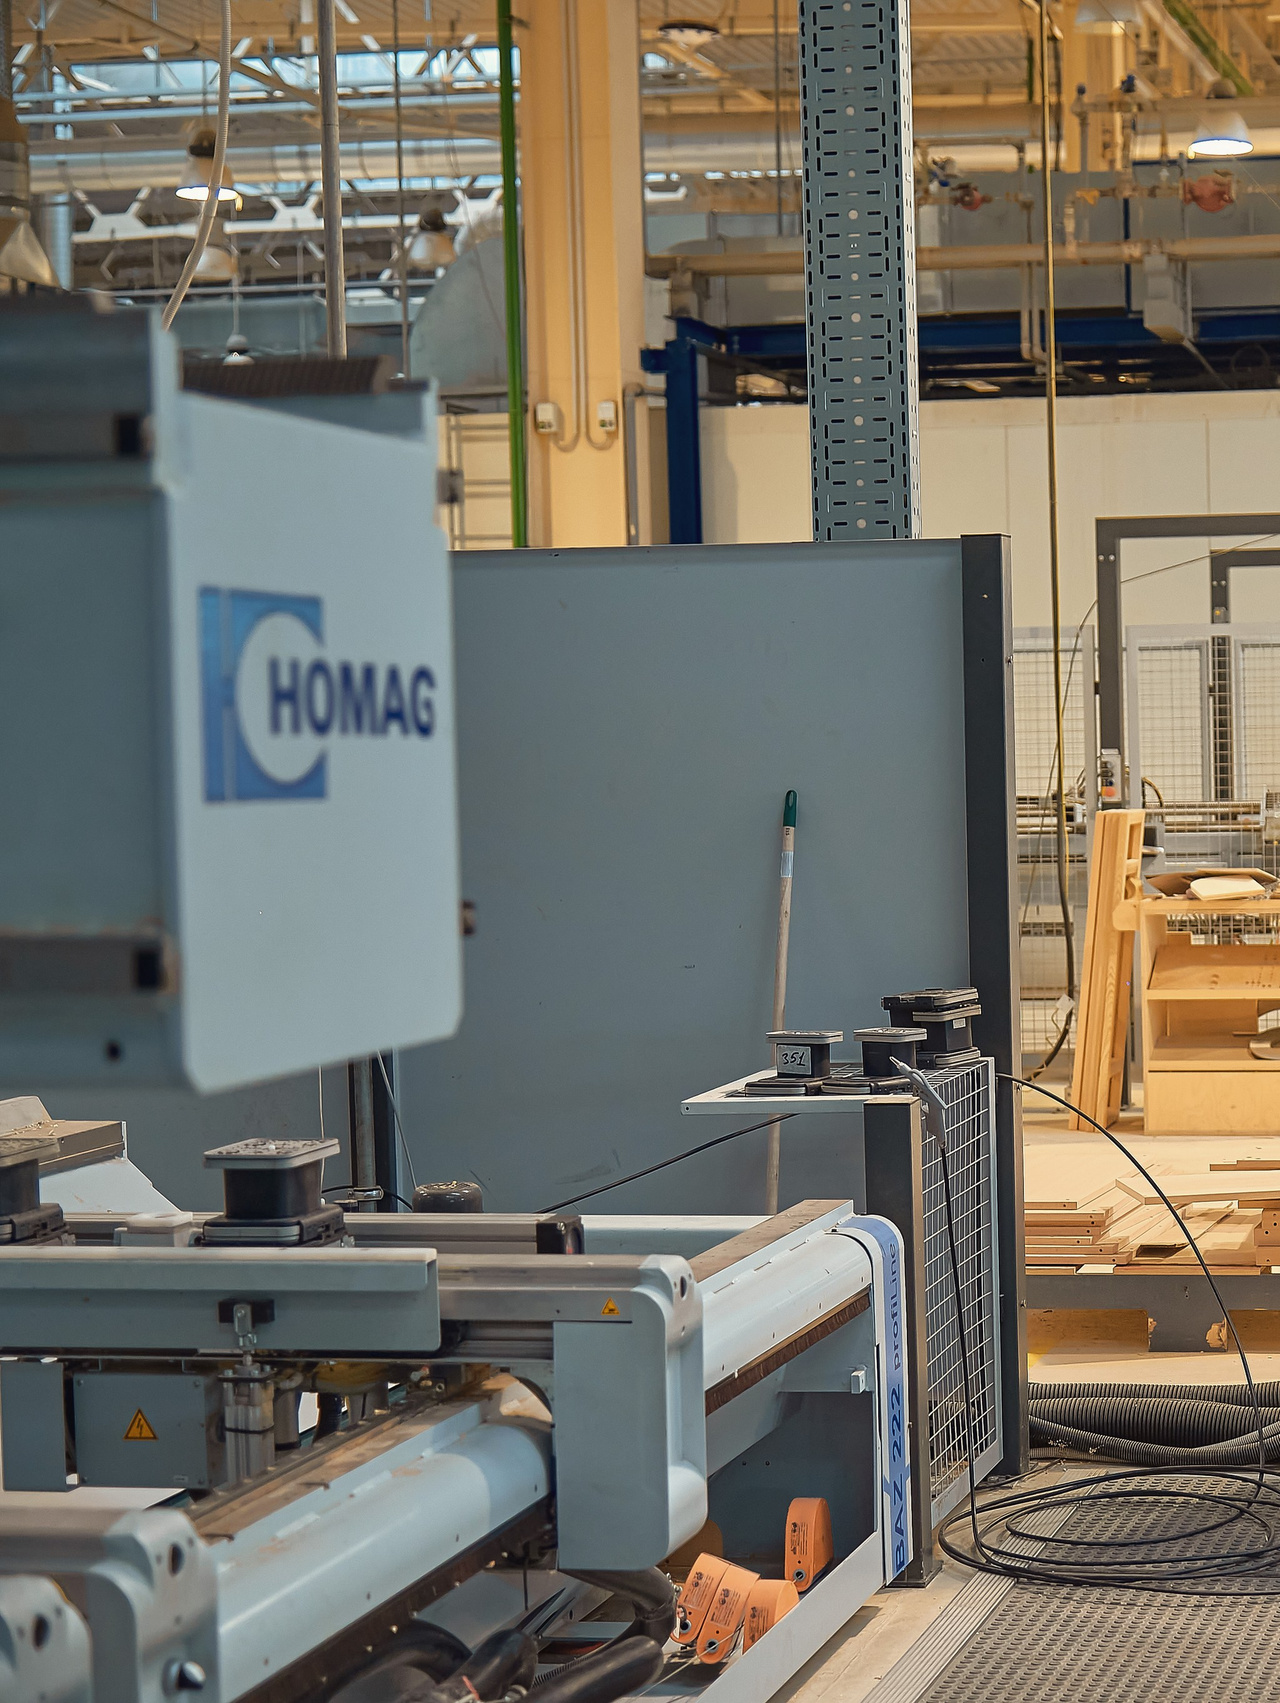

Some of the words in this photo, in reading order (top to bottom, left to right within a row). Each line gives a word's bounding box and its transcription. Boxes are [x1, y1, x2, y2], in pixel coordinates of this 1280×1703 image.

[268, 656, 437, 738] HOMAG
[782, 1051, 806, 1067] 351
[889, 1243, 901, 1371] profiLine
[890, 1383, 902, 1463] 222
[893, 1473, 906, 1573] BAZ
